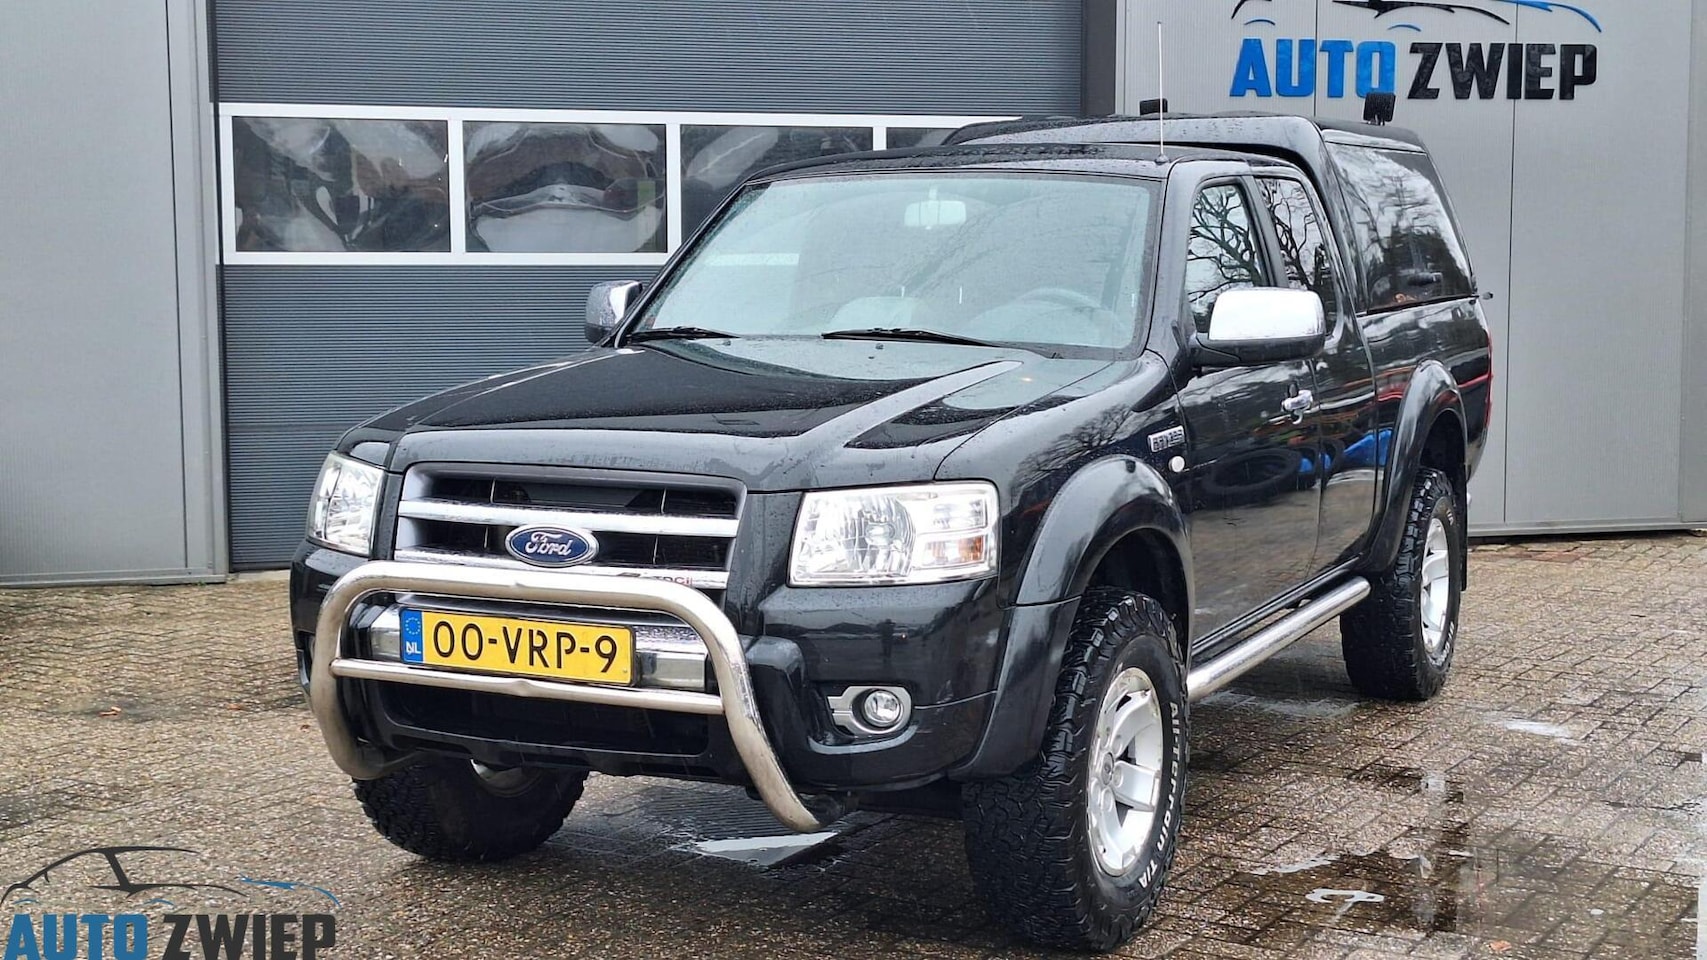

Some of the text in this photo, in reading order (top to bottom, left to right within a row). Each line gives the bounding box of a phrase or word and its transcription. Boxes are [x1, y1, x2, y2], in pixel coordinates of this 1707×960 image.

[1229, 38, 1598, 100] AUTO ZWIEP
[525, 531, 573, 556] Ford
[405, 641, 422, 655] NL
[433, 620, 618, 673] 00-VRP-9
[1139, 859, 1158, 888] T/A
